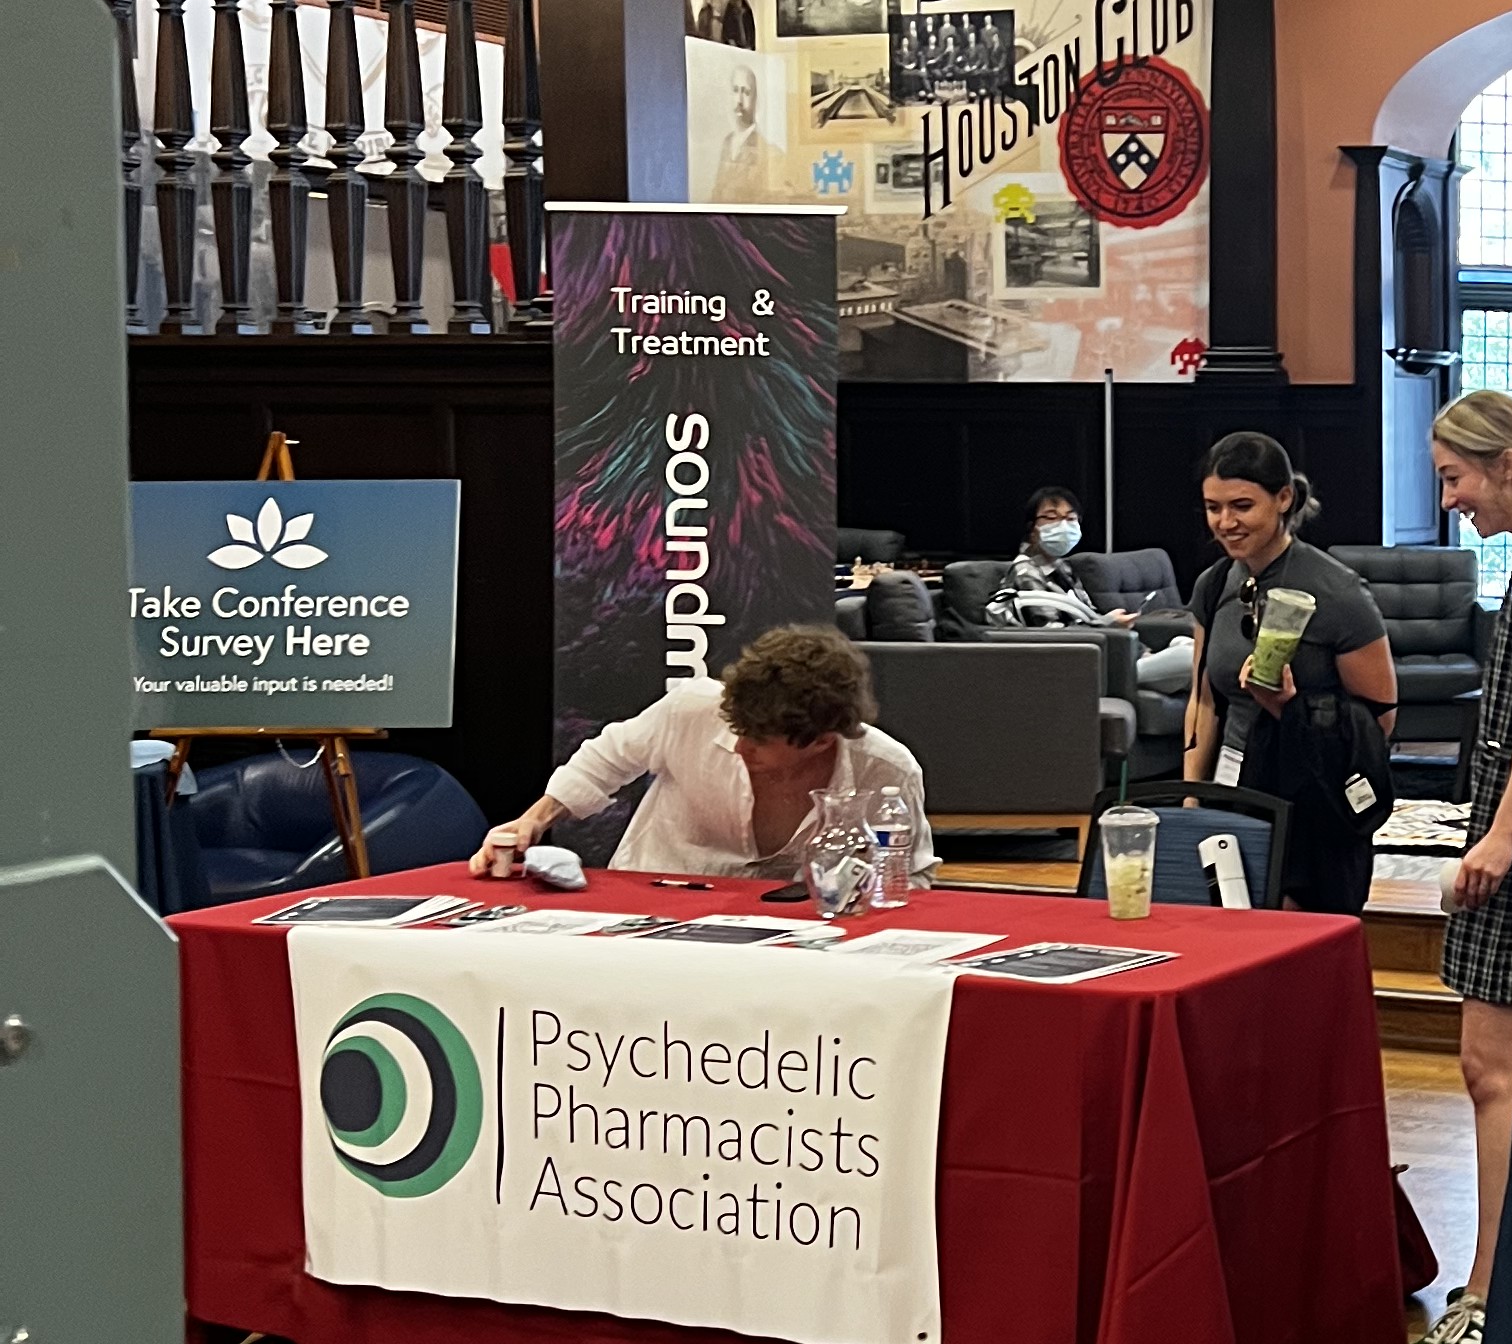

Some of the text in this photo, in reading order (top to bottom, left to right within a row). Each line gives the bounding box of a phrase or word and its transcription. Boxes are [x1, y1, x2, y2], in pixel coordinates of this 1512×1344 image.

[610, 287, 776, 323] Training &
[610, 326, 771, 357] Treatment
[128, 584, 410, 619] Take Conference
[159, 624, 371, 666] Survey Here
[133, 673, 394, 696] Your valuable input is needed!
[530, 1008, 879, 1103] Psychedelic
[533, 1081, 881, 1180] Pharmacists
[529, 1155, 861, 1251] Association
